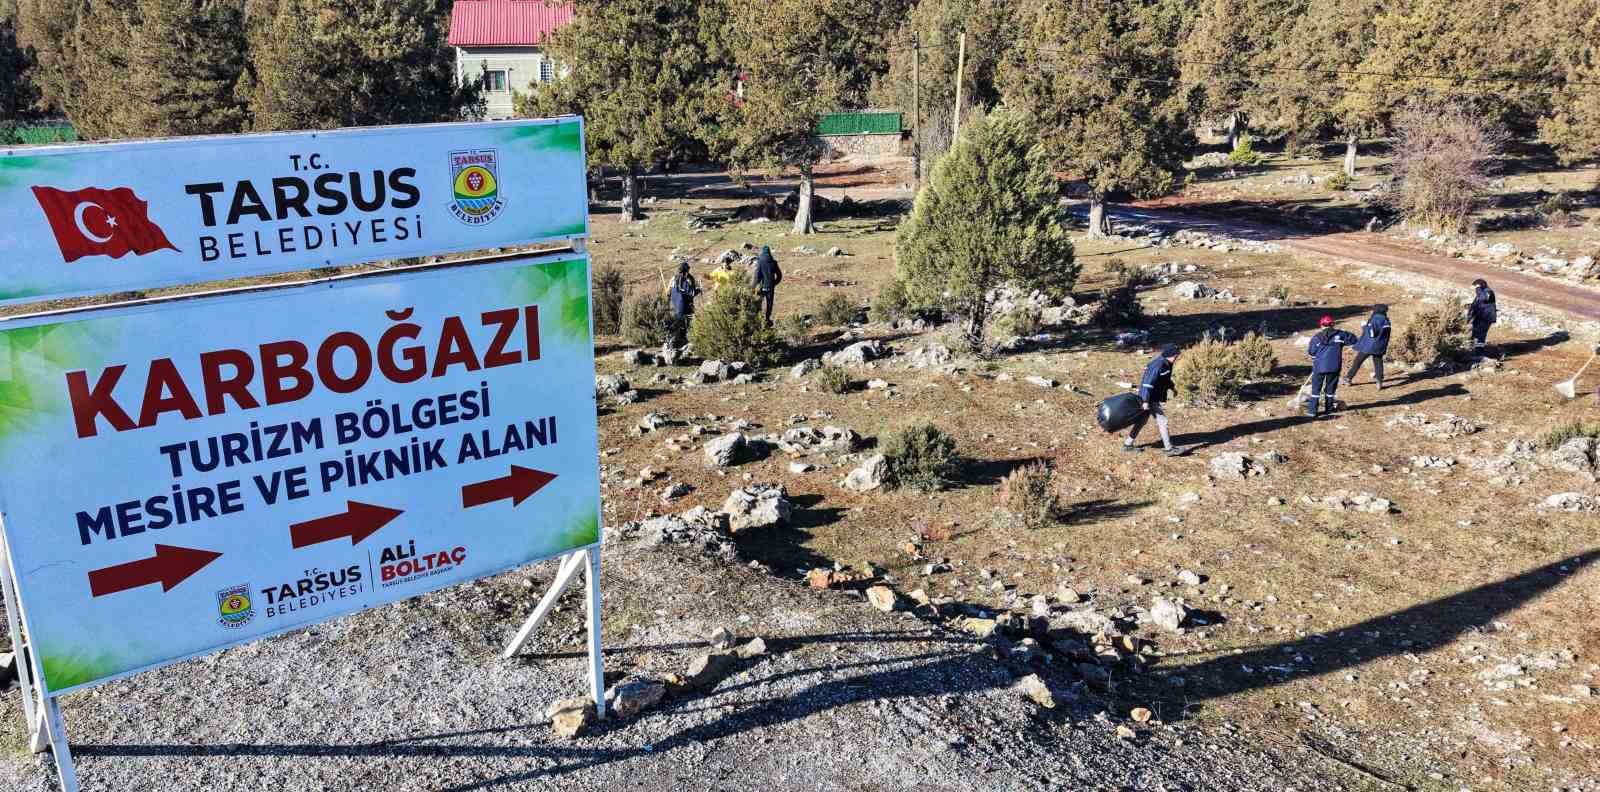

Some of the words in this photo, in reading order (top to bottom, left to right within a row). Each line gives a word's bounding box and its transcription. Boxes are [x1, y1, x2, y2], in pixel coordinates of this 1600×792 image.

[290, 153, 330, 171] T.C.
[184, 167, 420, 226] TARSUS
[200, 215, 422, 262] BELEDİYESİ
[66, 305, 541, 438] KARBOĞAZI
[160, 411, 324, 478] TURİZM
[336, 381, 491, 445] BÖLGESİ
[76, 480, 245, 546] MESİRE
[254, 464, 310, 505] VE
[321, 440, 448, 493] PİKNİK
[458, 417, 558, 465] ALANI
[380, 539, 416, 564] ALİ
[381, 546, 467, 581] BOLTAÇ
[261, 565, 362, 604] TARSUS
